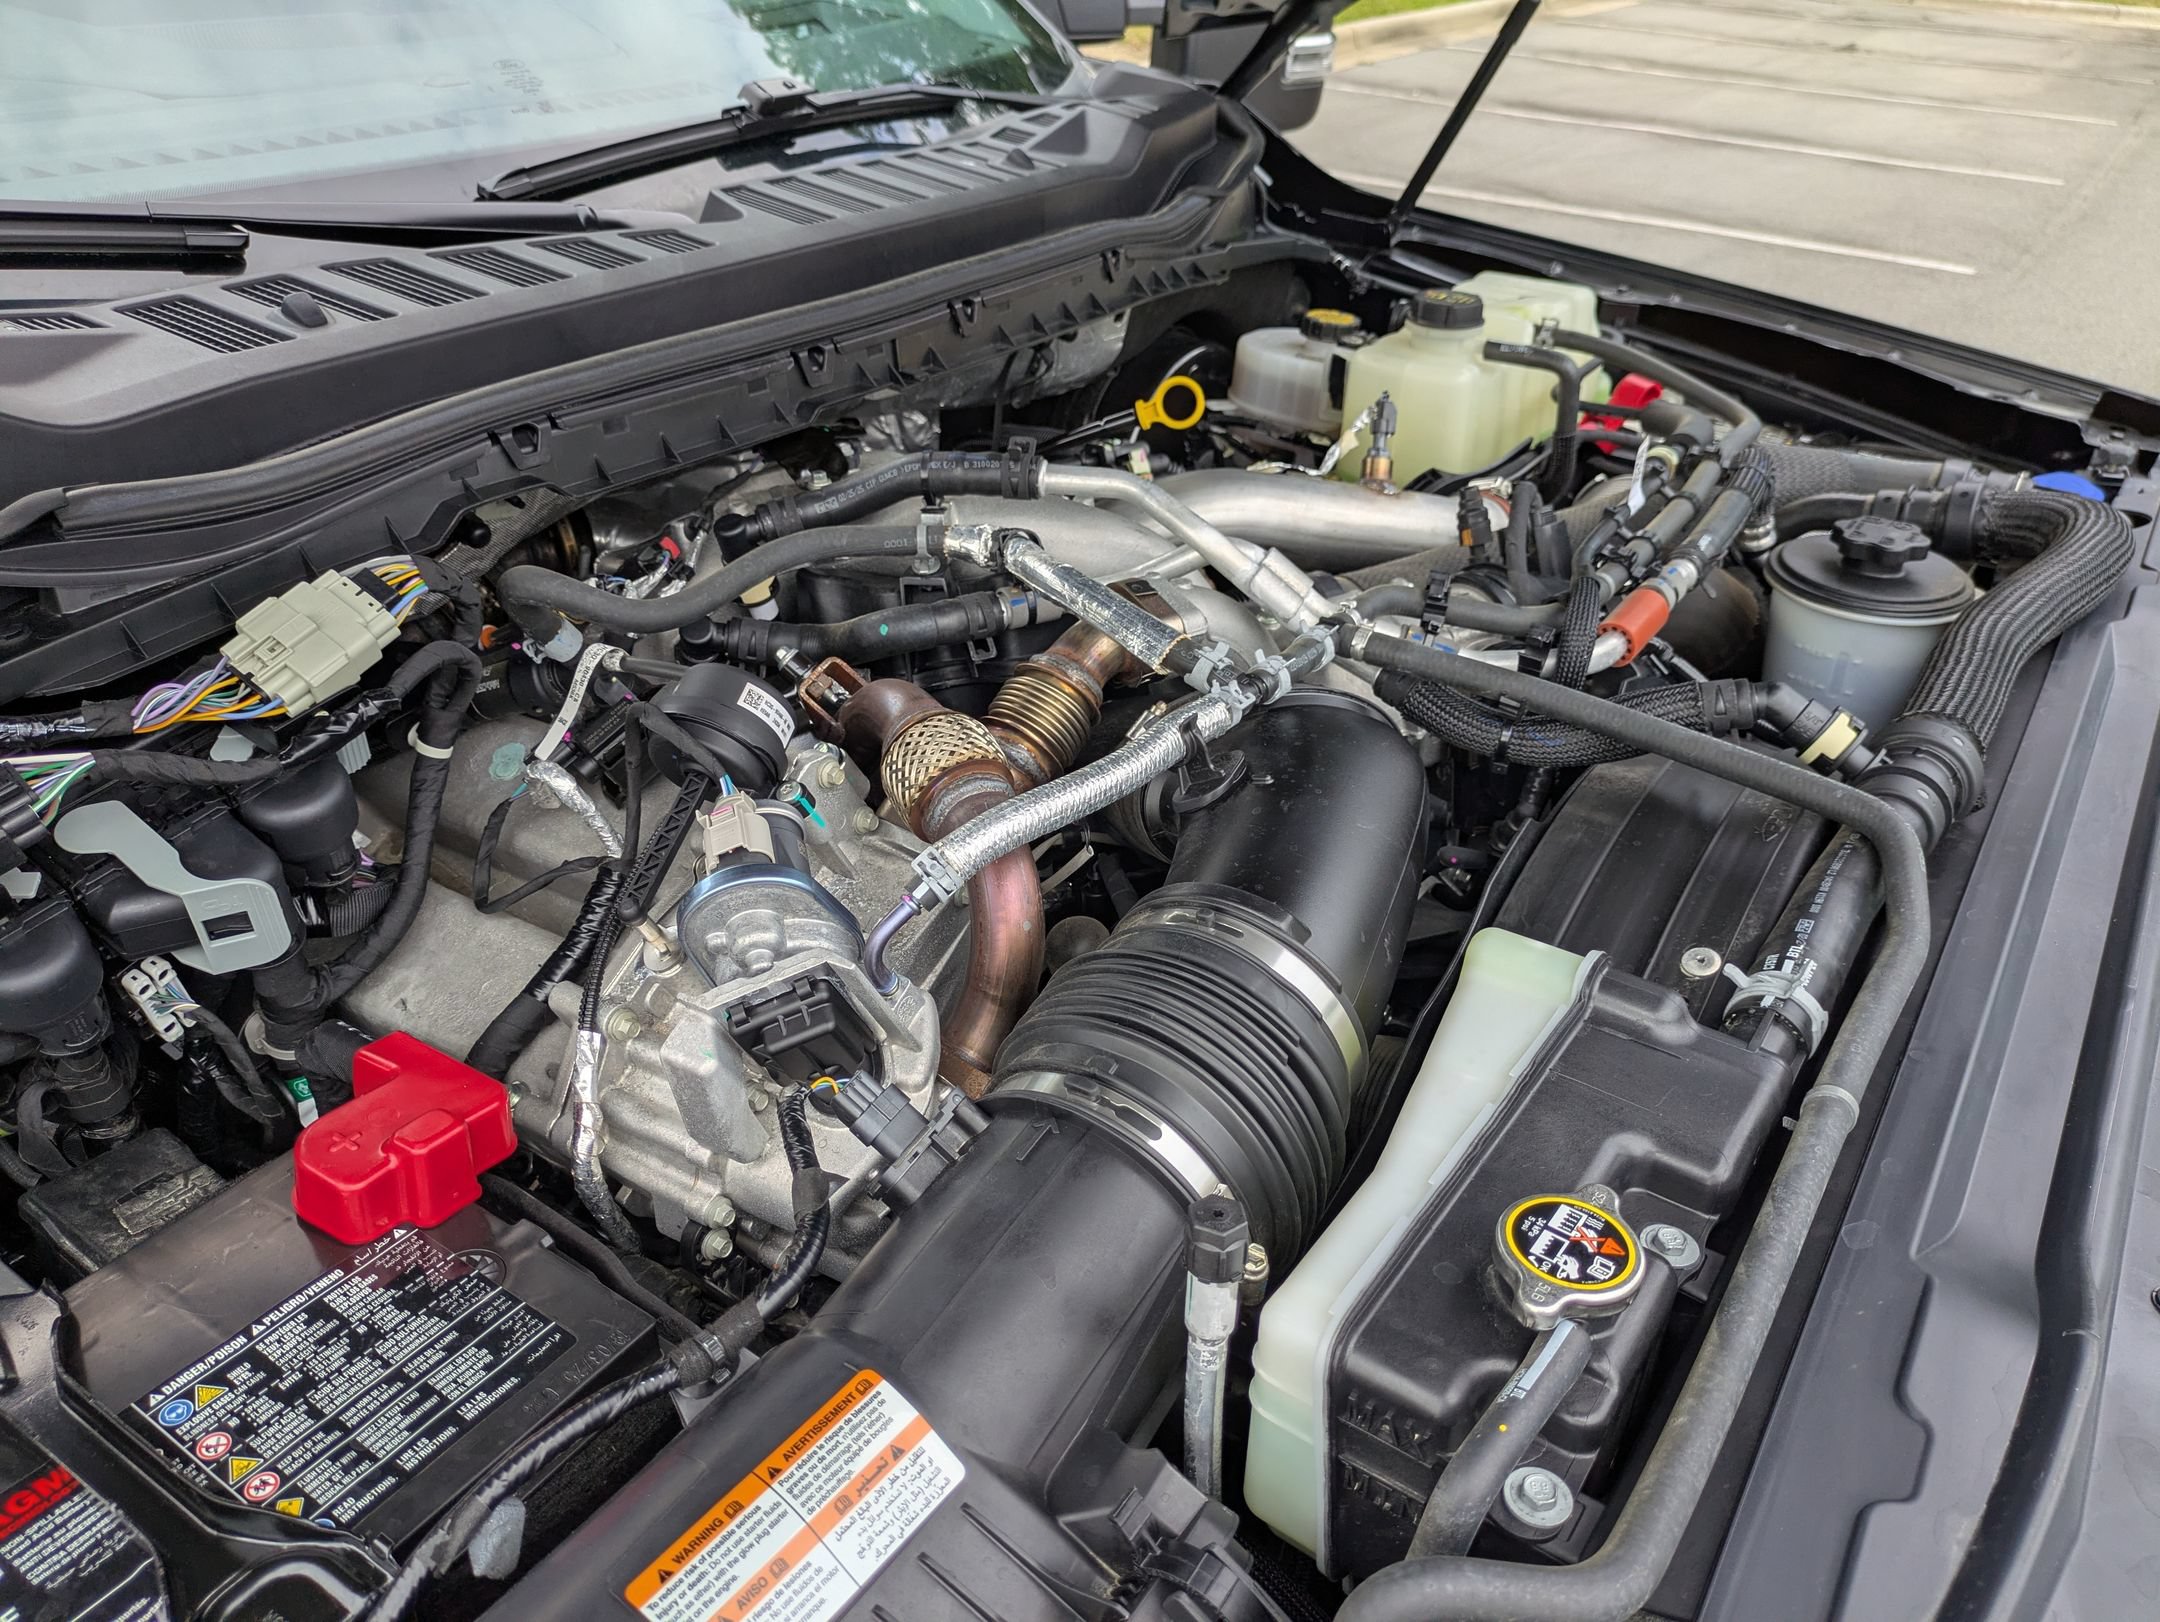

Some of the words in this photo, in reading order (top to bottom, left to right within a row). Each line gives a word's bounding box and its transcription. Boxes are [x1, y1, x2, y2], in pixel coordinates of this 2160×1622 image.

[1538, 1260, 1550, 1272] OK
[261, 1268, 345, 1325] PELIGRO/VENENO
[370, 1303, 395, 1322] CHISPAS
[355, 1324, 369, 1334] NO
[160, 1334, 248, 1394] DANGER/POISON
[226, 1361, 252, 1380] SHIELD
[277, 1370, 303, 1390] ÉVITEZ
[331, 1356, 372, 1386] SULFURIQUE
[175, 1407, 215, 1435] EXPLOSIVE
[211, 1392, 236, 1410] GASES
[232, 1383, 248, 1395] CAN
[245, 1370, 267, 1386] CAUSE
[181, 1414, 218, 1441] BLINDNESS
[215, 1407, 227, 1417] OR
[224, 1391, 250, 1411] INJURY.
[226, 1416, 241, 1427] NO
[243, 1394, 269, 1414] SPARKS
[249, 1399, 276, 1419] FLAMES
[255, 1401, 286, 1424] SMOKING
[456, 1401, 473, 1415] LEA
[470, 1390, 487, 1404] LAS
[248, 1421, 283, 1448] SULFURIC
[279, 1411, 297, 1425] ACID
[293, 1403, 308, 1415] CAN
[255, 1436, 277, 1453] CAUSE
[274, 1413, 308, 1439] BLINDNESS
[261, 1448, 274, 1458] OR
[270, 1432, 295, 1451] SEVERE
[777, 1469, 796, 1488] Pour
[794, 1449, 817, 1471] réduire
[816, 1441, 825, 1451] le
[823, 1424, 845, 1445] risque
[842, 1415, 853, 1426] de
[851, 1390, 880, 1417] blessures
[782, 1392, 856, 1461] AVERTISSEMENT
[786, 1472, 809, 1494] graves
[807, 1462, 818, 1473] ou
[815, 1453, 826, 1464] de
[865, 1405, 879, 1419] pas
[875, 1397, 886, 1407] de
[275, 1455, 294, 1469] KEEP
[291, 1446, 306, 1458] OUT
[303, 1439, 314, 1448] OF
[311, 1430, 326, 1442] THE
[282, 1457, 306, 1475] REACH
[302, 1450, 314, 1460] OF
[311, 1428, 344, 1453] CHILDREN.
[395, 1448, 416, 1465] LIRE
[412, 1436, 430, 1451] LES
[792, 1480, 813, 1500] fluides
[811, 1470, 822, 1482] de
[820, 1443, 853, 1473] démarrage
[850, 1429, 866, 1445] (tels
[798, 1490, 816, 1508] avec
[814, 1483, 824, 1493] ce
[822, 1464, 843, 1484] moteur
[842, 1445, 865, 1466] équipé
[861, 1436, 872, 1447] de
[870, 1416, 894, 1439] bougies
[295, 1470, 318, 1487] FLUSH
[314, 1458, 332, 1473] EYES
[302, 1461, 342, 1493] IMMEDIATELY
[339, 1449, 357, 1464] WITH
[315, 1481, 344, 1505] MEDICAL
[340, 1470, 358, 1485] HELP
[354, 1458, 374, 1474] FAST.
[330, 1469, 346, 1481] GET
[331, 1496, 356, 1517] READ
[805, 1503, 816, 1515] de
[646, 1598, 659, 1612] To
[658, 1576, 683, 1601] reduce
[682, 1561, 699, 1579] risk
[696, 1553, 707, 1565] of
[705, 1527, 737, 1558] possible
[734, 1503, 761, 1529] serious
[672, 1516, 723, 1565] WARNING
[678, 1589, 687, 1599] or
[686, 1567, 709, 1590] death:
[708, 1556, 721, 1570] Do
[719, 1545, 732, 1560] not
[731, 1535, 745, 1549] use
[743, 1516, 764, 1536] starter
[762, 1498, 782, 1518] fluids
[683, 1599, 694, 1610] as
[693, 1579, 714, 1601] ether)
[712, 1565, 728, 1582] with
[726, 1554, 740, 1569] the
[737, 1540, 756, 1559] glow
[752, 1526, 771, 1545] plug
[767, 1509, 788, 1529] starter
[692, 1606, 704, 1618] on
[701, 1594, 715, 1609] the
[737, 1575, 768, 1610] AVISO
[750, 1597, 775, 1621] riesgo
[772, 1586, 784, 1599] de
[782, 1560, 812, 1588] lesiones
[768, 1606, 782, 1620] No
[779, 1594, 794, 1609] use
[792, 1574, 815, 1596] fluidos
[812, 1564, 823, 1576] de
[789, 1591, 815, 1616] arranca
[812, 1582, 822, 1593] el
[820, 1566, 839, 1584] motor
